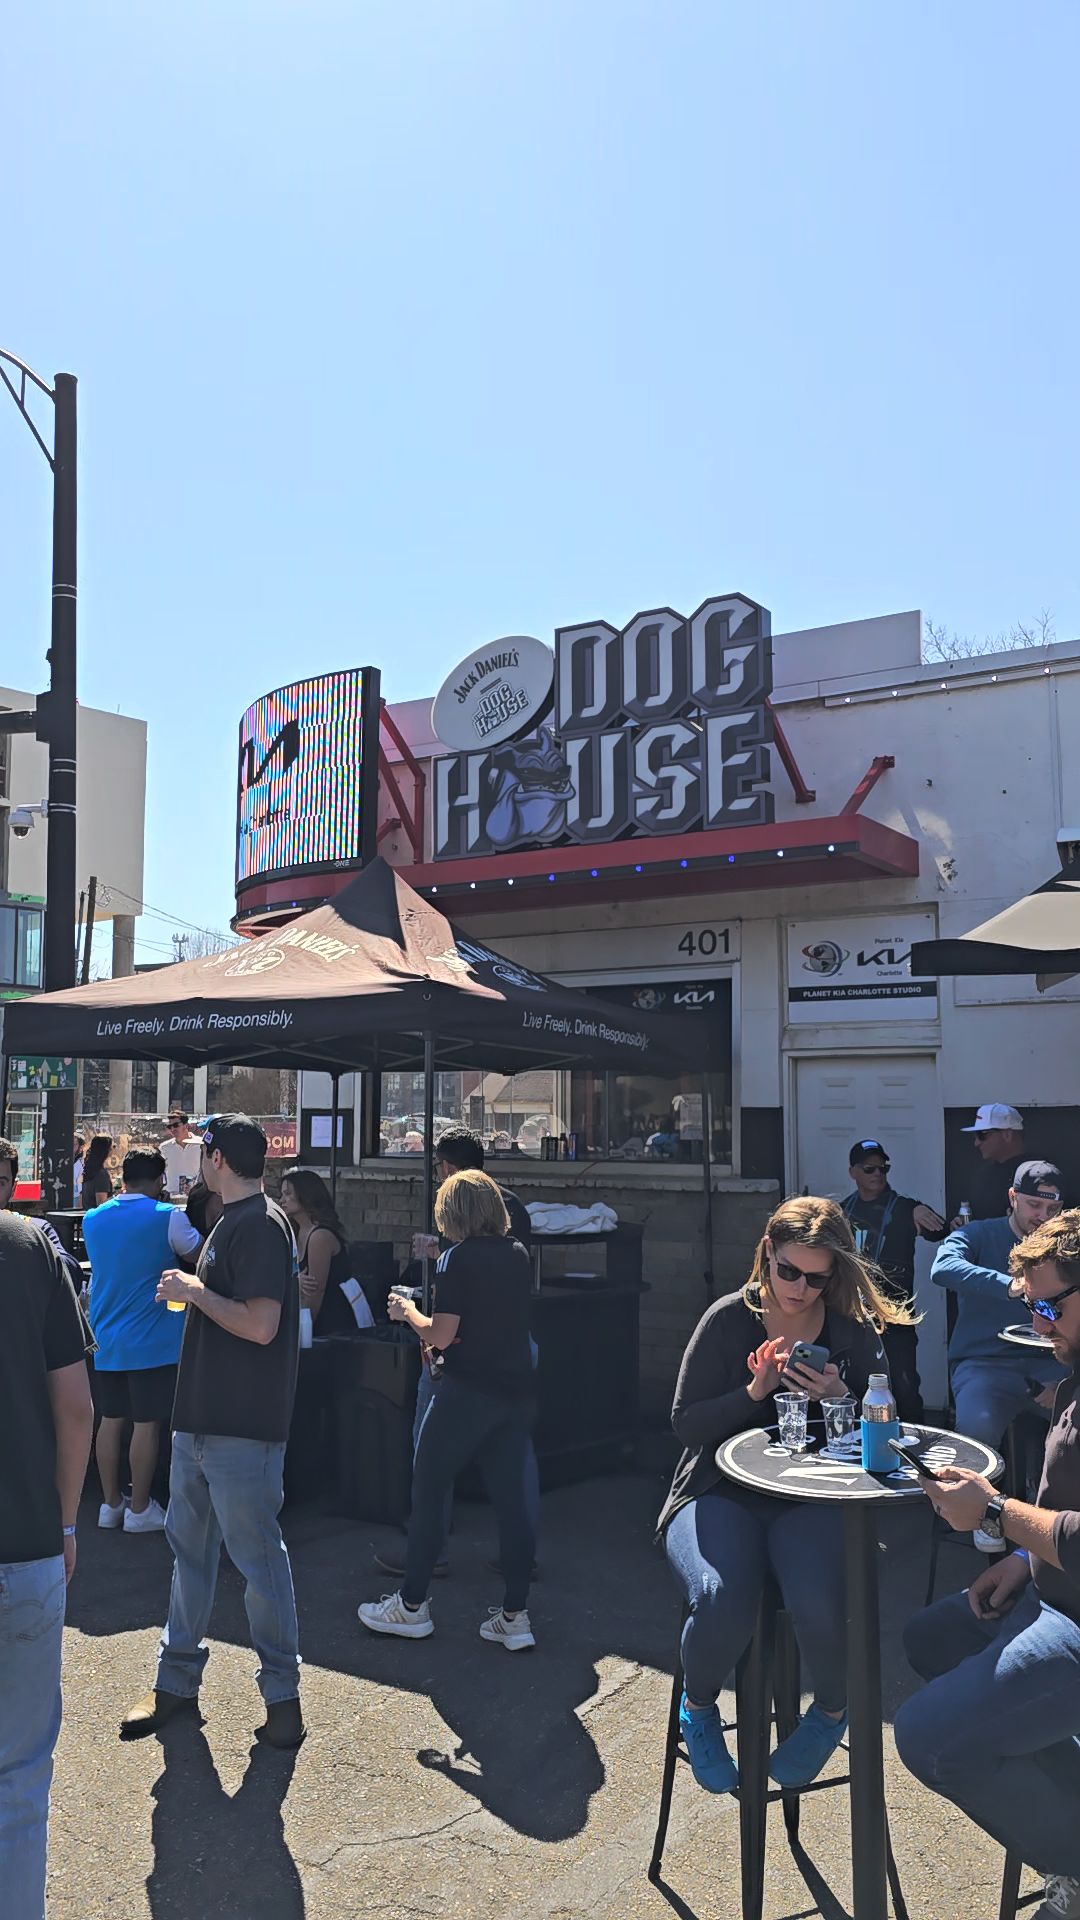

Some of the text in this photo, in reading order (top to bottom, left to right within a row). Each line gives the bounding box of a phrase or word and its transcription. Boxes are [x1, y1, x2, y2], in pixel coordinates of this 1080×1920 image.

[453, 648, 520, 704] JACK DANIEL'S
[555, 592, 766, 733] DOG
[475, 689, 529, 737] HUSE
[479, 683, 512, 716] DOG
[433, 705, 769, 861] HUSE
[678, 928, 730, 956] 401
[803, 986, 922, 998] PLANET KIA CHARLOTTE STUDIO
[96, 1009, 294, 1036] Live Freely. Drink Responsibly.
[522, 1010, 650, 1052] Live Freely. Drink Responsibly.
